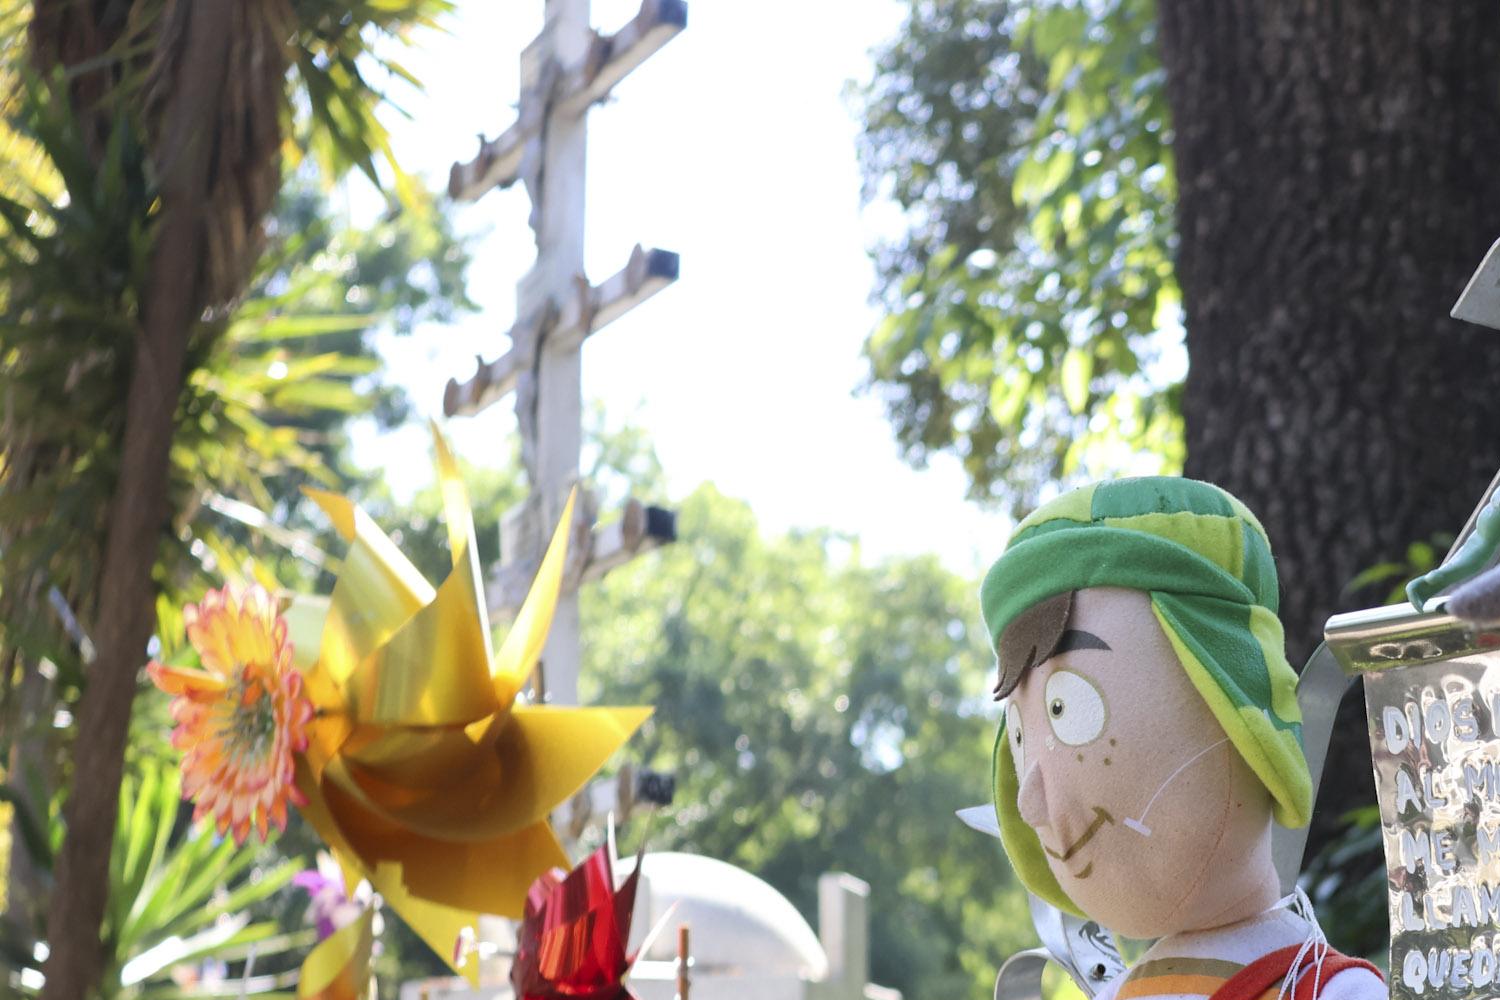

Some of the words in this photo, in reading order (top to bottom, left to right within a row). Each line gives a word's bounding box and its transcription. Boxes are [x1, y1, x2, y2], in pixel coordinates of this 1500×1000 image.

[1383, 698, 1480, 755] DIOS
[1396, 769, 1447, 815] AL
[1401, 830, 1457, 874] ME
